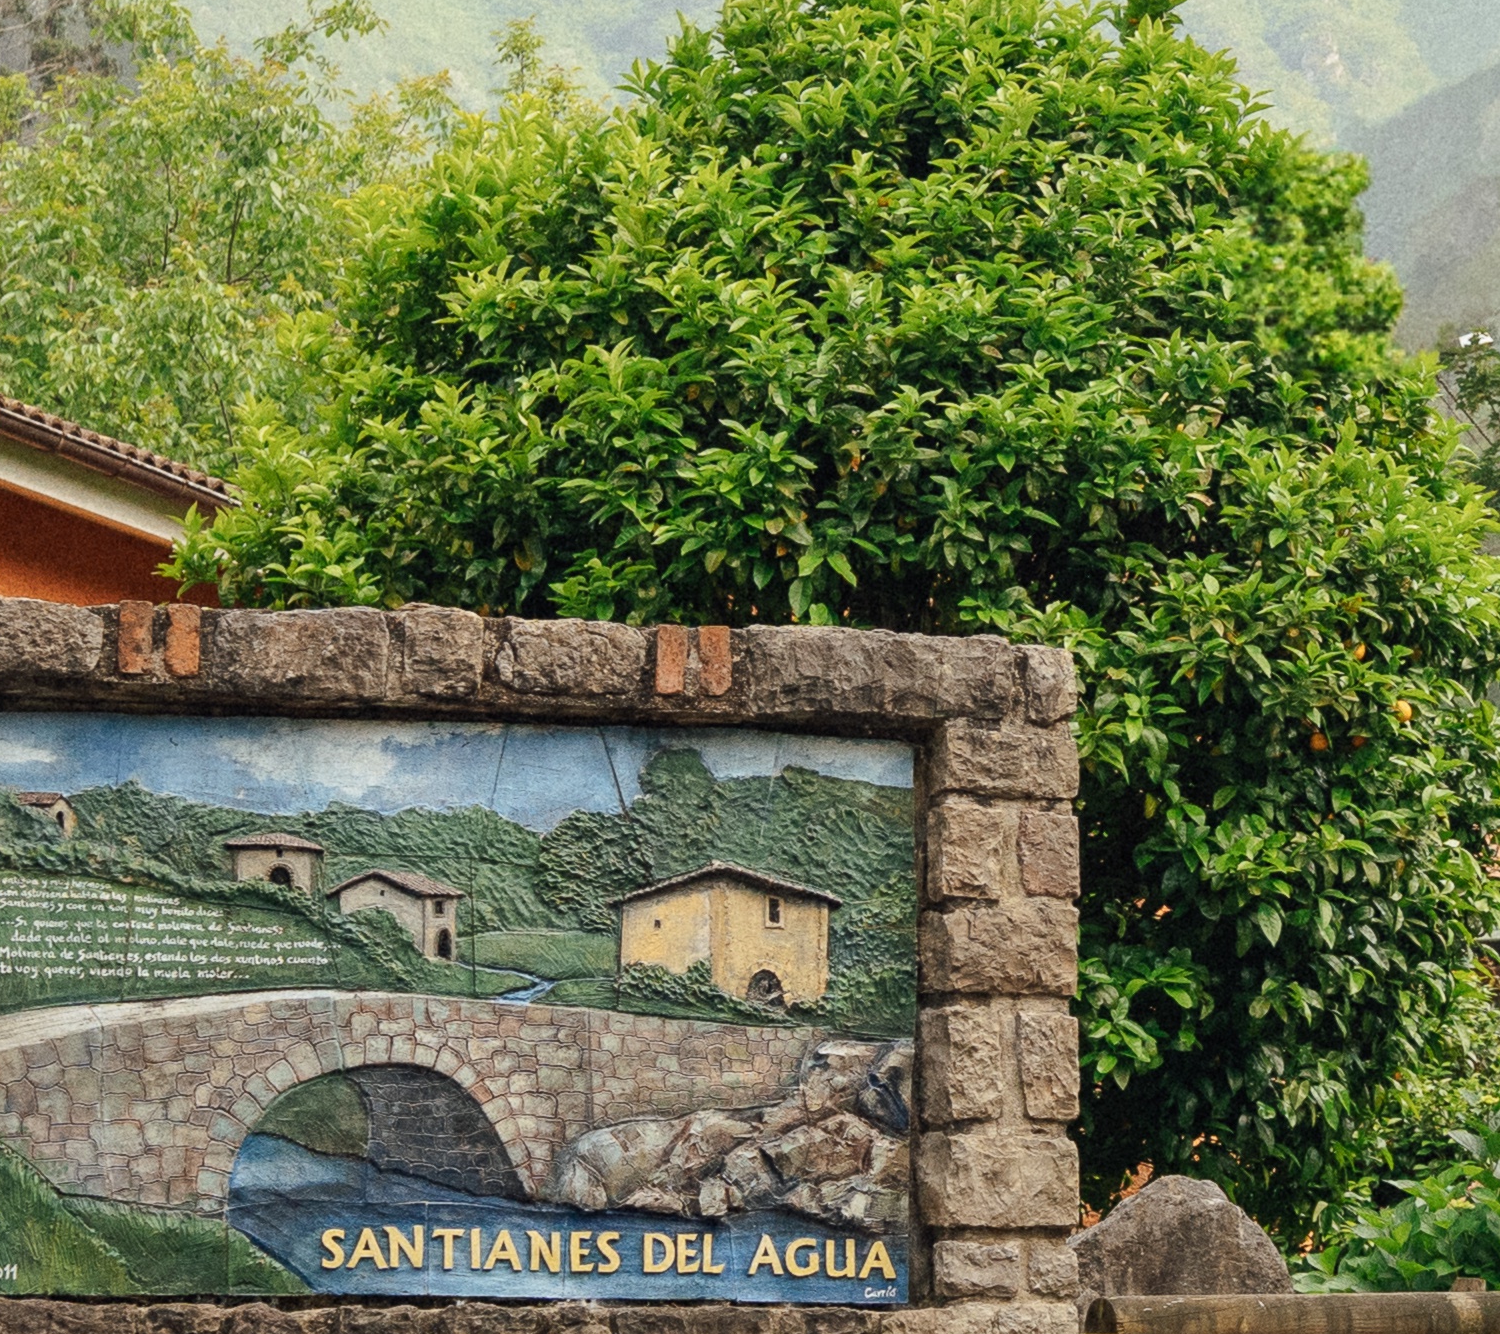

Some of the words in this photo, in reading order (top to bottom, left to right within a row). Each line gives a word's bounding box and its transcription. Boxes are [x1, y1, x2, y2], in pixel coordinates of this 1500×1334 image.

[41, 879, 48, 888] y
[49, 880, 70, 890] muy
[56, 902, 64, 913] y
[66, 903, 88, 911] con
[92, 904, 105, 912] un
[108, 904, 129, 914] son
[135, 905, 158, 919] muy
[161, 906, 195, 917] bonito
[74, 919, 94, 931] que
[95, 917, 108, 929] te
[157, 921, 205, 932] molinera
[208, 921, 223, 932] de
[189, 938, 209, 950] que
[274, 942, 292, 952] que
[0, 946, 56, 960] Molinera
[60, 948, 74, 960] de
[144, 951, 188, 963] estando
[190, 952, 207, 965] los
[210, 952, 231, 964] dos
[0, 962, 13, 974] te
[15, 966, 39, 979] voy
[89, 966, 132, 977] viendo
[138, 965, 150, 977] la
[154, 967, 191, 978] muela
[320, 1224, 621, 1273] SANTIANES
[642, 1232, 726, 1274] DEL
[746, 1232, 896, 1279] AGUA
